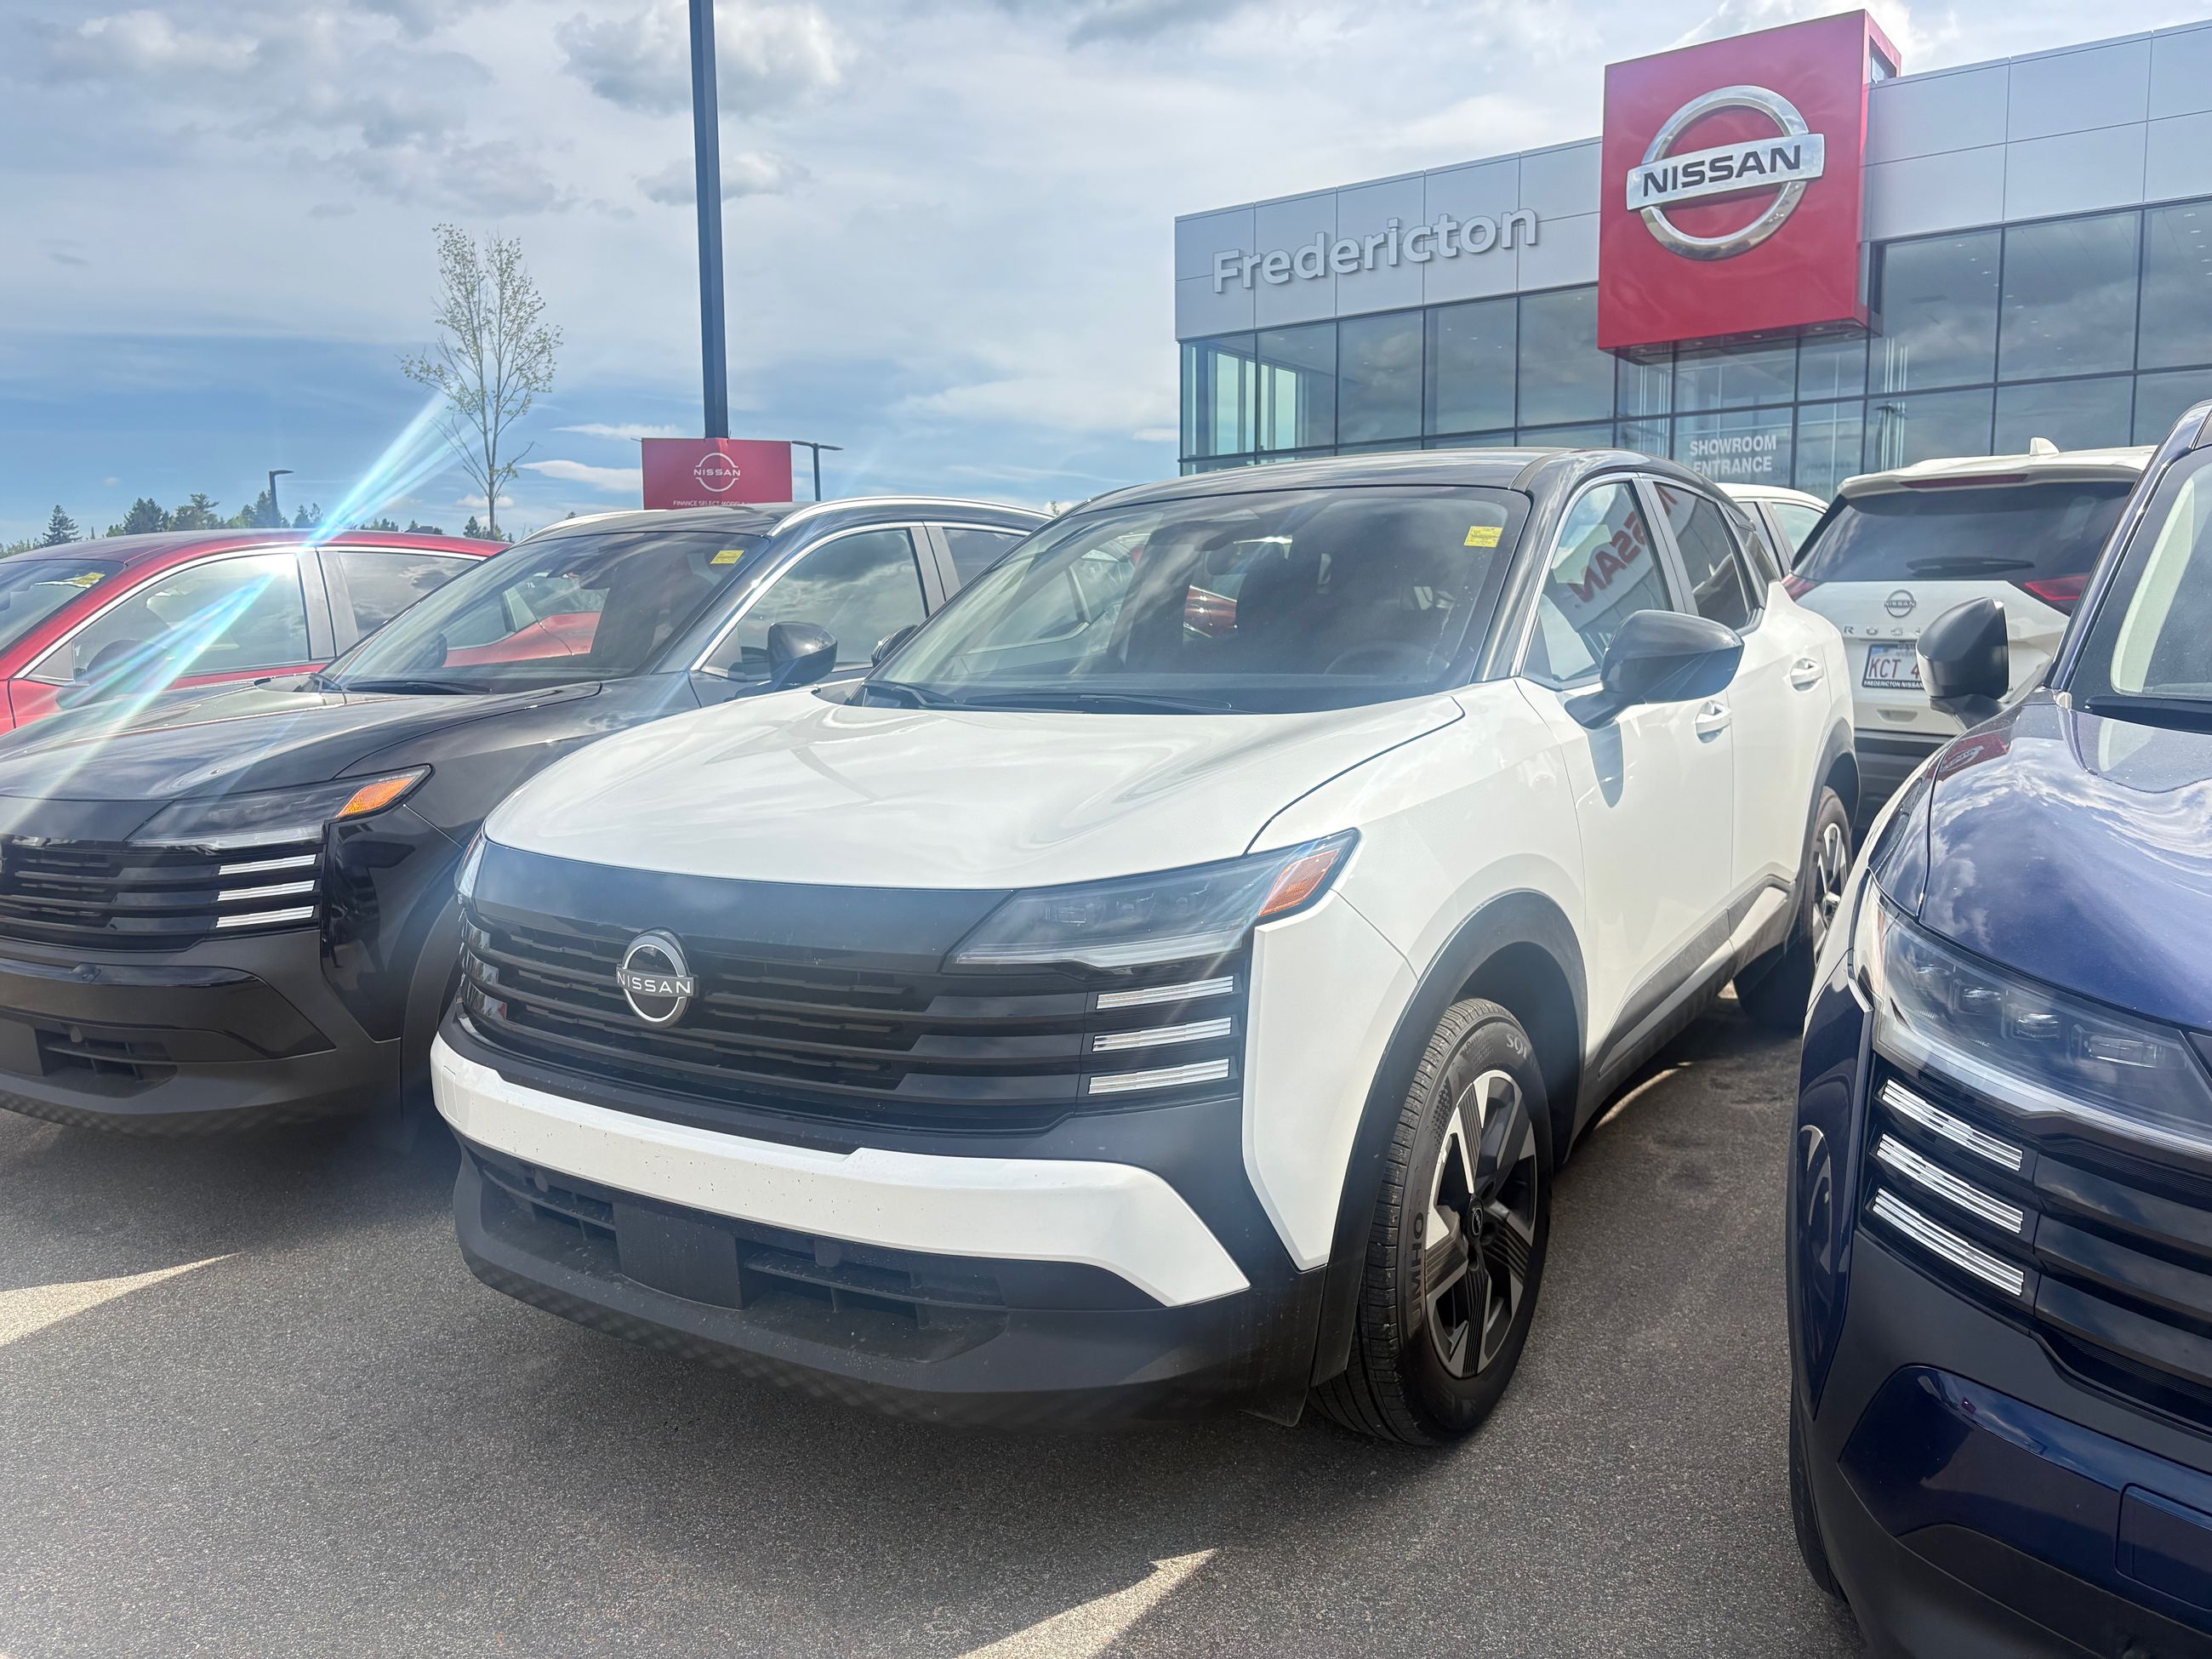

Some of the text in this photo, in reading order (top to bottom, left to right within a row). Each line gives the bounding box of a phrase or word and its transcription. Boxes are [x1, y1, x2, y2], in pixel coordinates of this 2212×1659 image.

[1643, 144, 1801, 197] NISSAN
[1212, 208, 1537, 294] Fredericton
[1690, 435, 1776, 456] SHOWROOM
[1693, 456, 1773, 476] ENTRANCE
[1884, 600, 1915, 608] NISSAN
[1867, 658, 1920, 679] KCT 4
[617, 971, 691, 994] NISSAN
